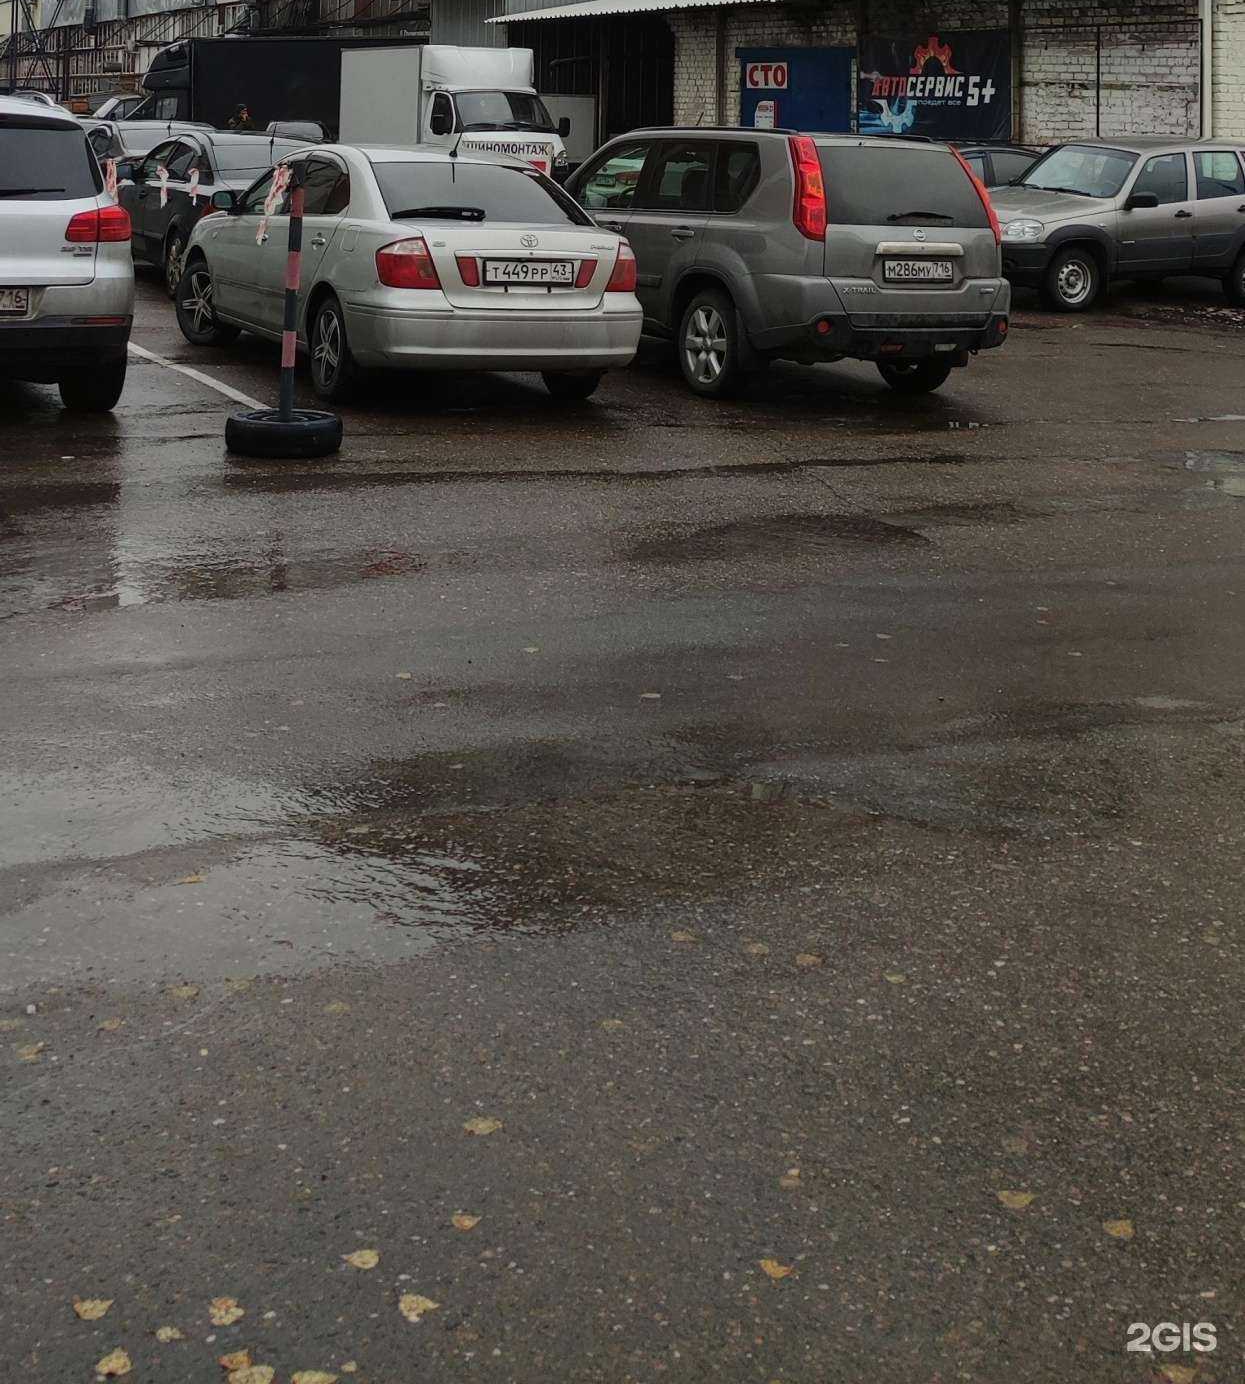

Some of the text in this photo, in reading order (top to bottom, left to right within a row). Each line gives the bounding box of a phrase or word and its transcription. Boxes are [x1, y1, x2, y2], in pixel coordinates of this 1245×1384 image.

[748, 65, 786, 87] СТО
[871, 76, 996, 106] АВТОСЕРВИС 5+
